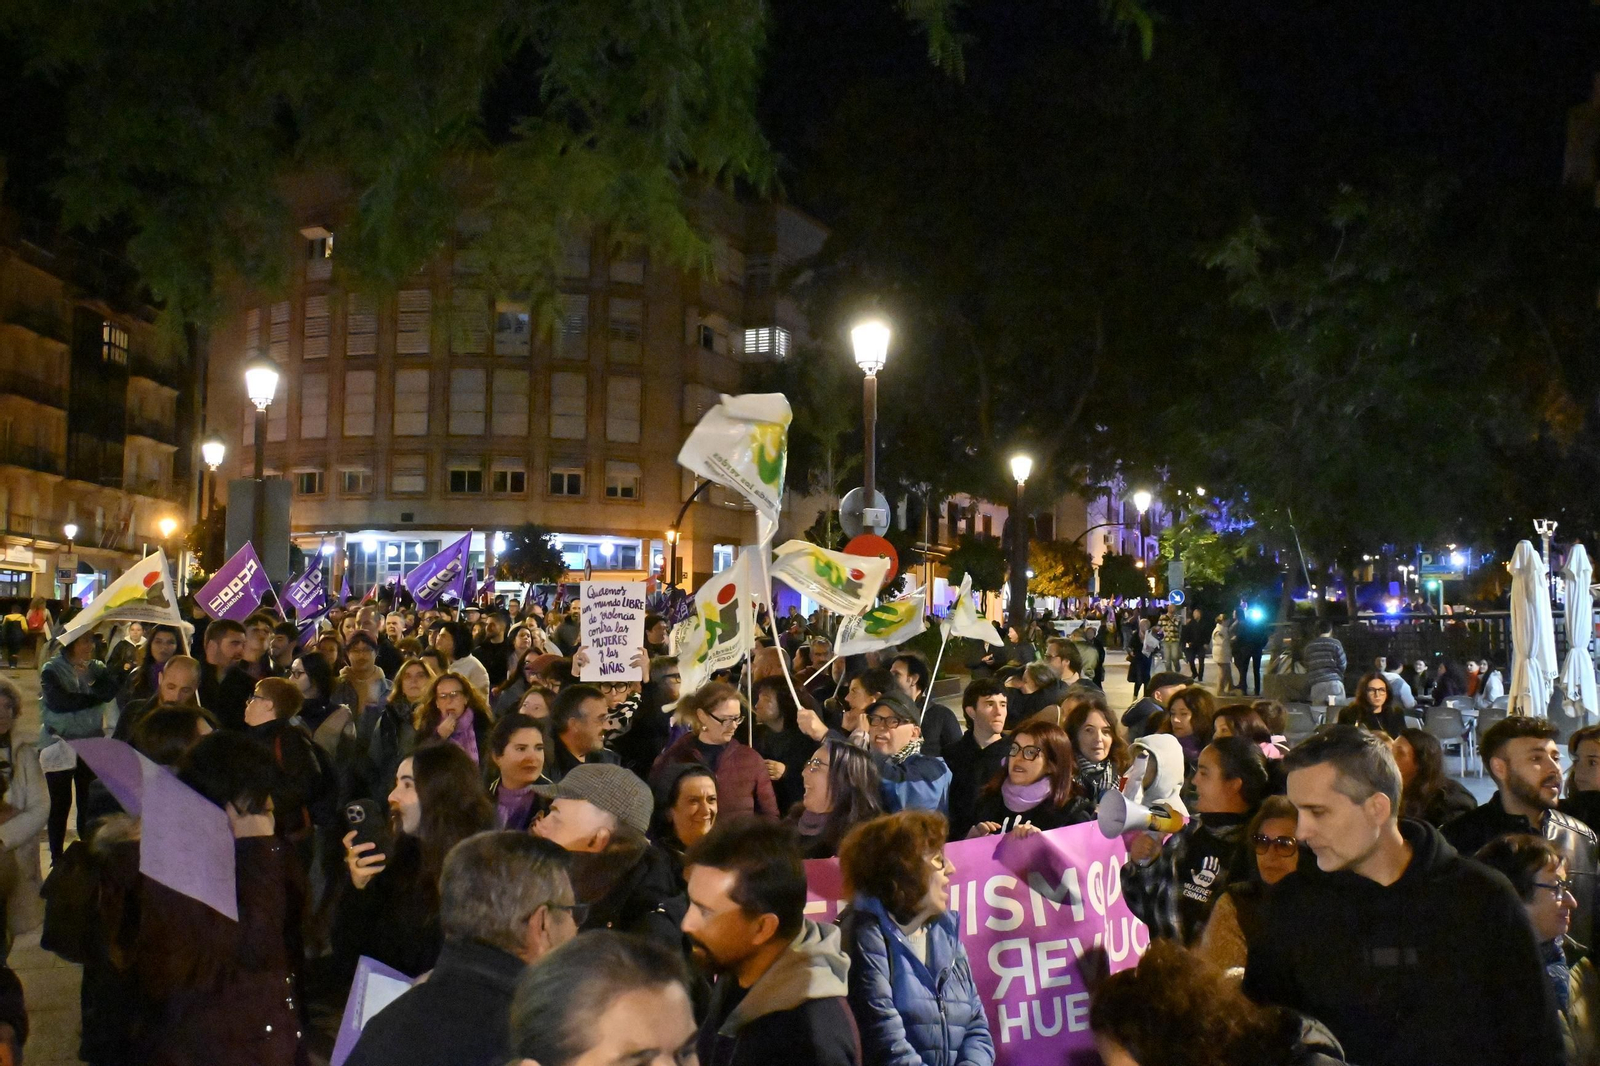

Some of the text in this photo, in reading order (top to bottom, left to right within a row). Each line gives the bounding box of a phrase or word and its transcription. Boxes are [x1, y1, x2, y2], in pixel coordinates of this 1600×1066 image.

[582, 596, 645, 615] un mundo LIBRE
[588, 608, 636, 625] de violencia
[588, 621, 629, 637] contra las
[591, 634, 628, 648] MUJERES
[598, 647, 619, 663] y las
